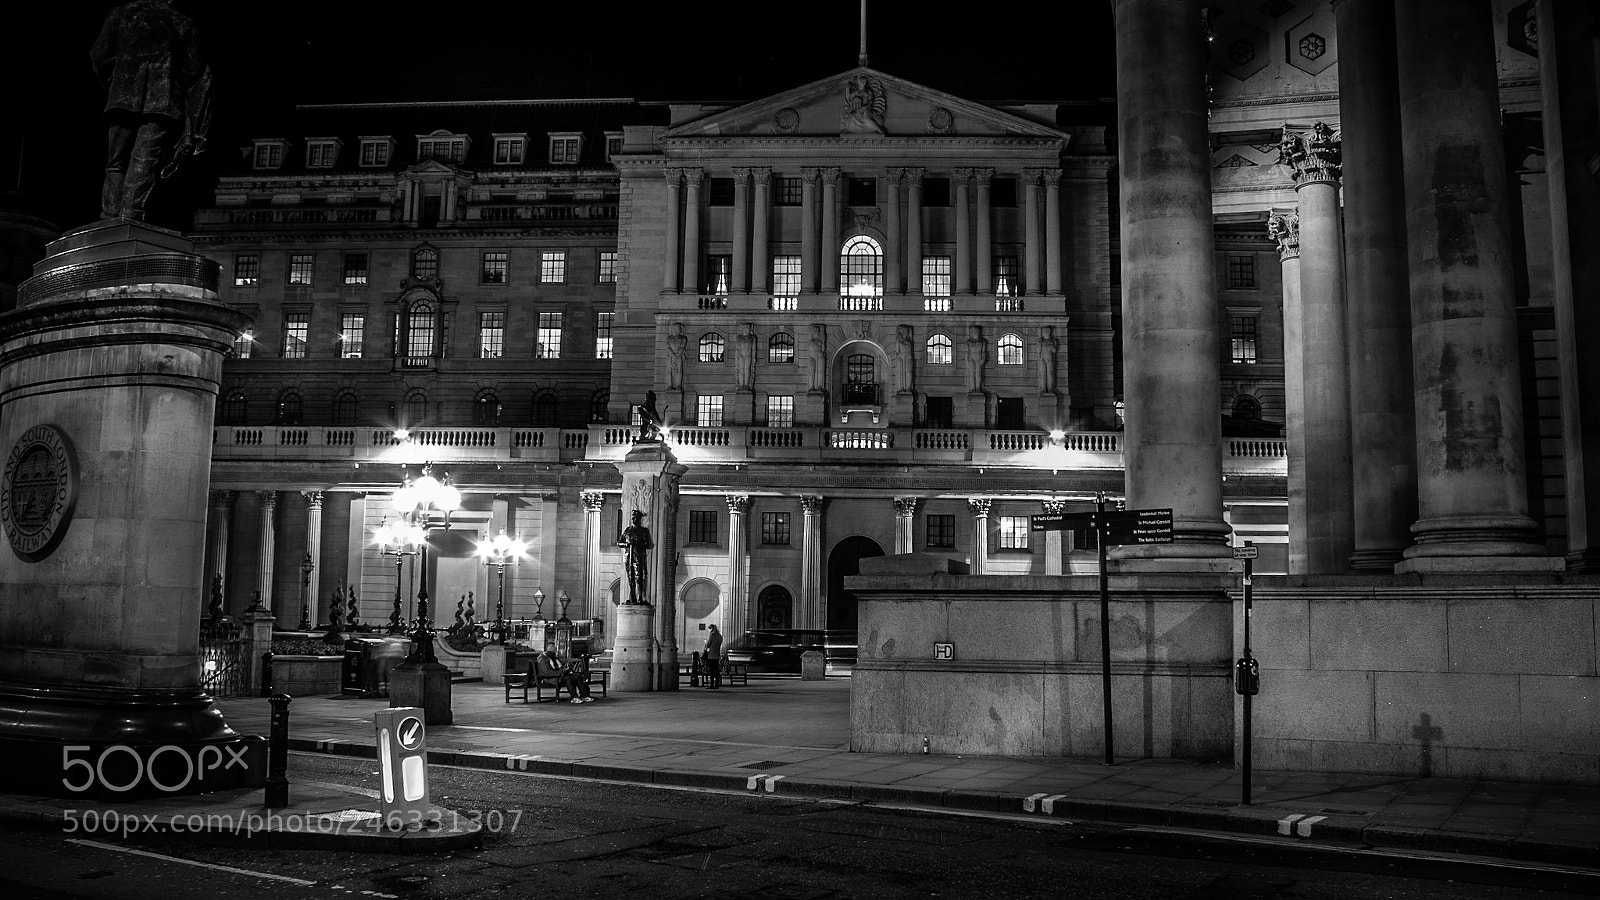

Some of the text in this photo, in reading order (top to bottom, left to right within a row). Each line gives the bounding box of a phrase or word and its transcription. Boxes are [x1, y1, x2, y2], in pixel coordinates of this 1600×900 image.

[1, 428, 68, 522] CITY AND SOUTH LONDON
[10, 527, 52, 551] RAILWAY
